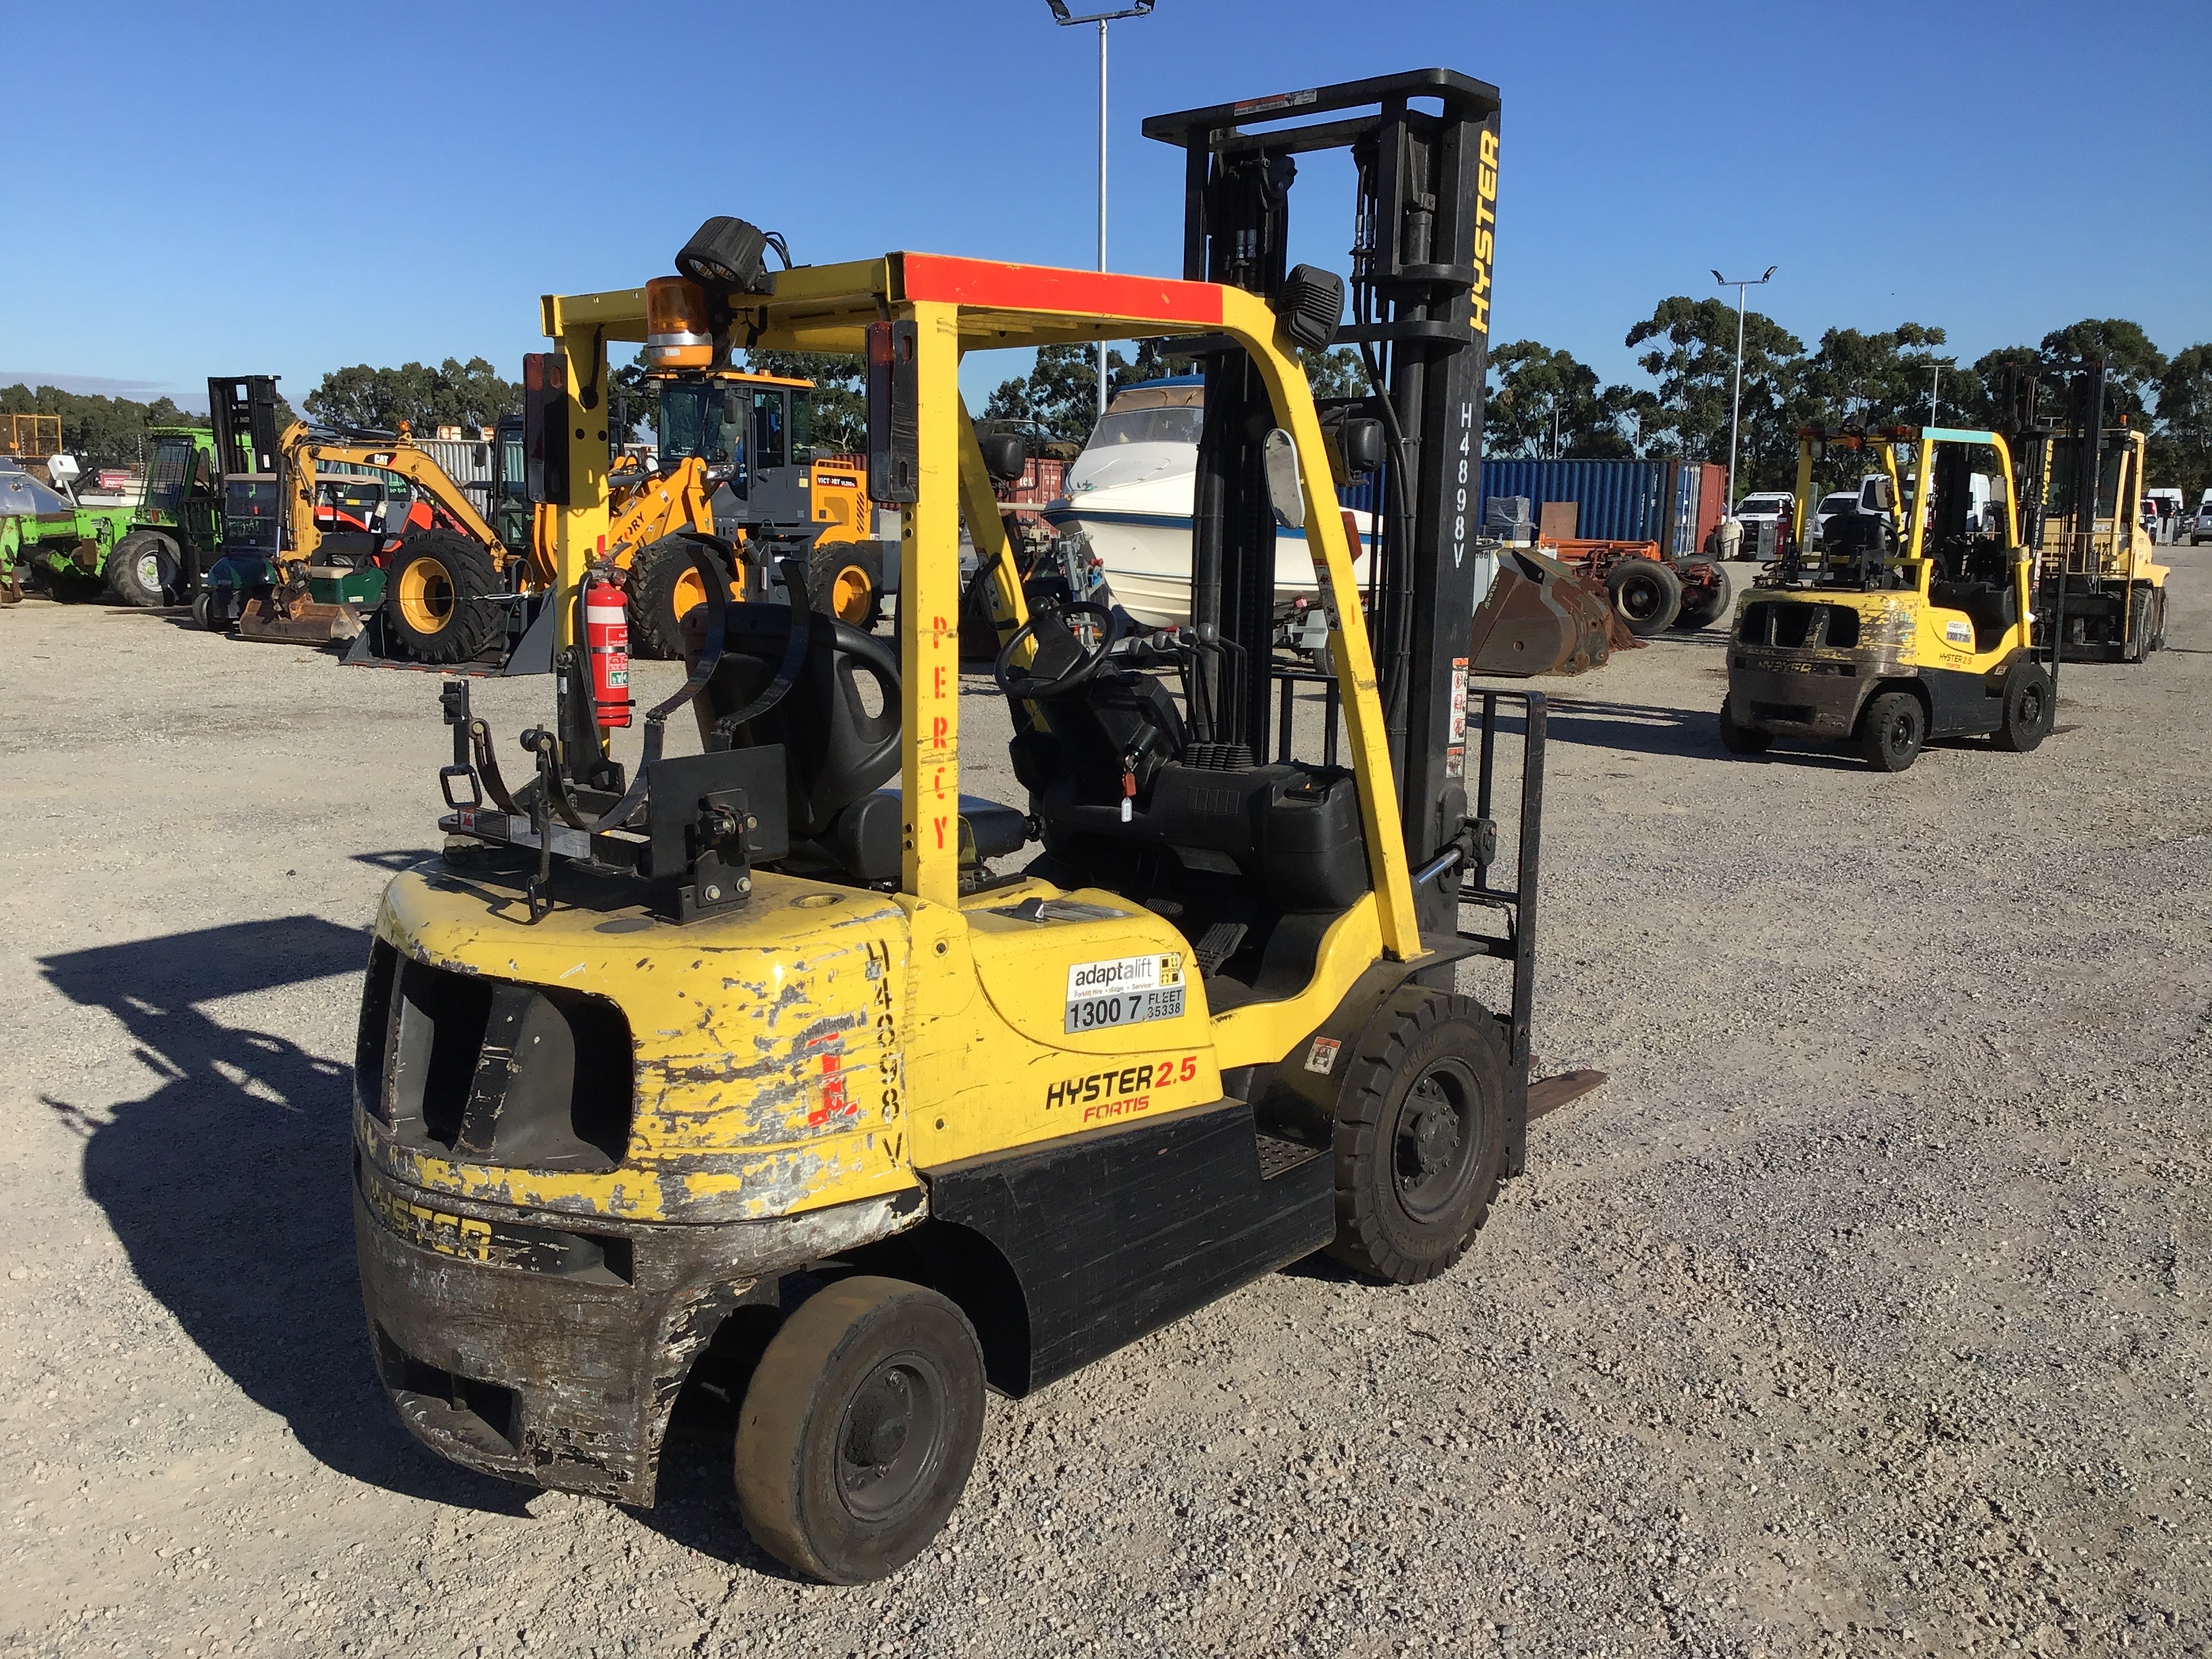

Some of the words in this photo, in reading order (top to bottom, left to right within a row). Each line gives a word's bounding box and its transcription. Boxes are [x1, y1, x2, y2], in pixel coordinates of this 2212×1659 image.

[1470, 130, 1498, 333] HYSTER
[374, 454, 388, 466] CAT
[2041, 439, 2053, 505] HYSTER
[1454, 403, 1472, 569] H4898V
[1939, 653, 1962, 663] HYSTER
[933, 616, 948, 849] PERCY
[1076, 958, 1152, 987] adaptalift
[1070, 998, 1121, 1029] 1300
[1128, 995, 1142, 1020] 7
[1147, 1002, 1181, 1019] 35338
[1148, 989, 1183, 1005] FLEET
[1046, 1065, 1153, 1110] HYSTER
[1155, 1056, 1197, 1088] 2.5
[1083, 1095, 1150, 1123] FORTIS
